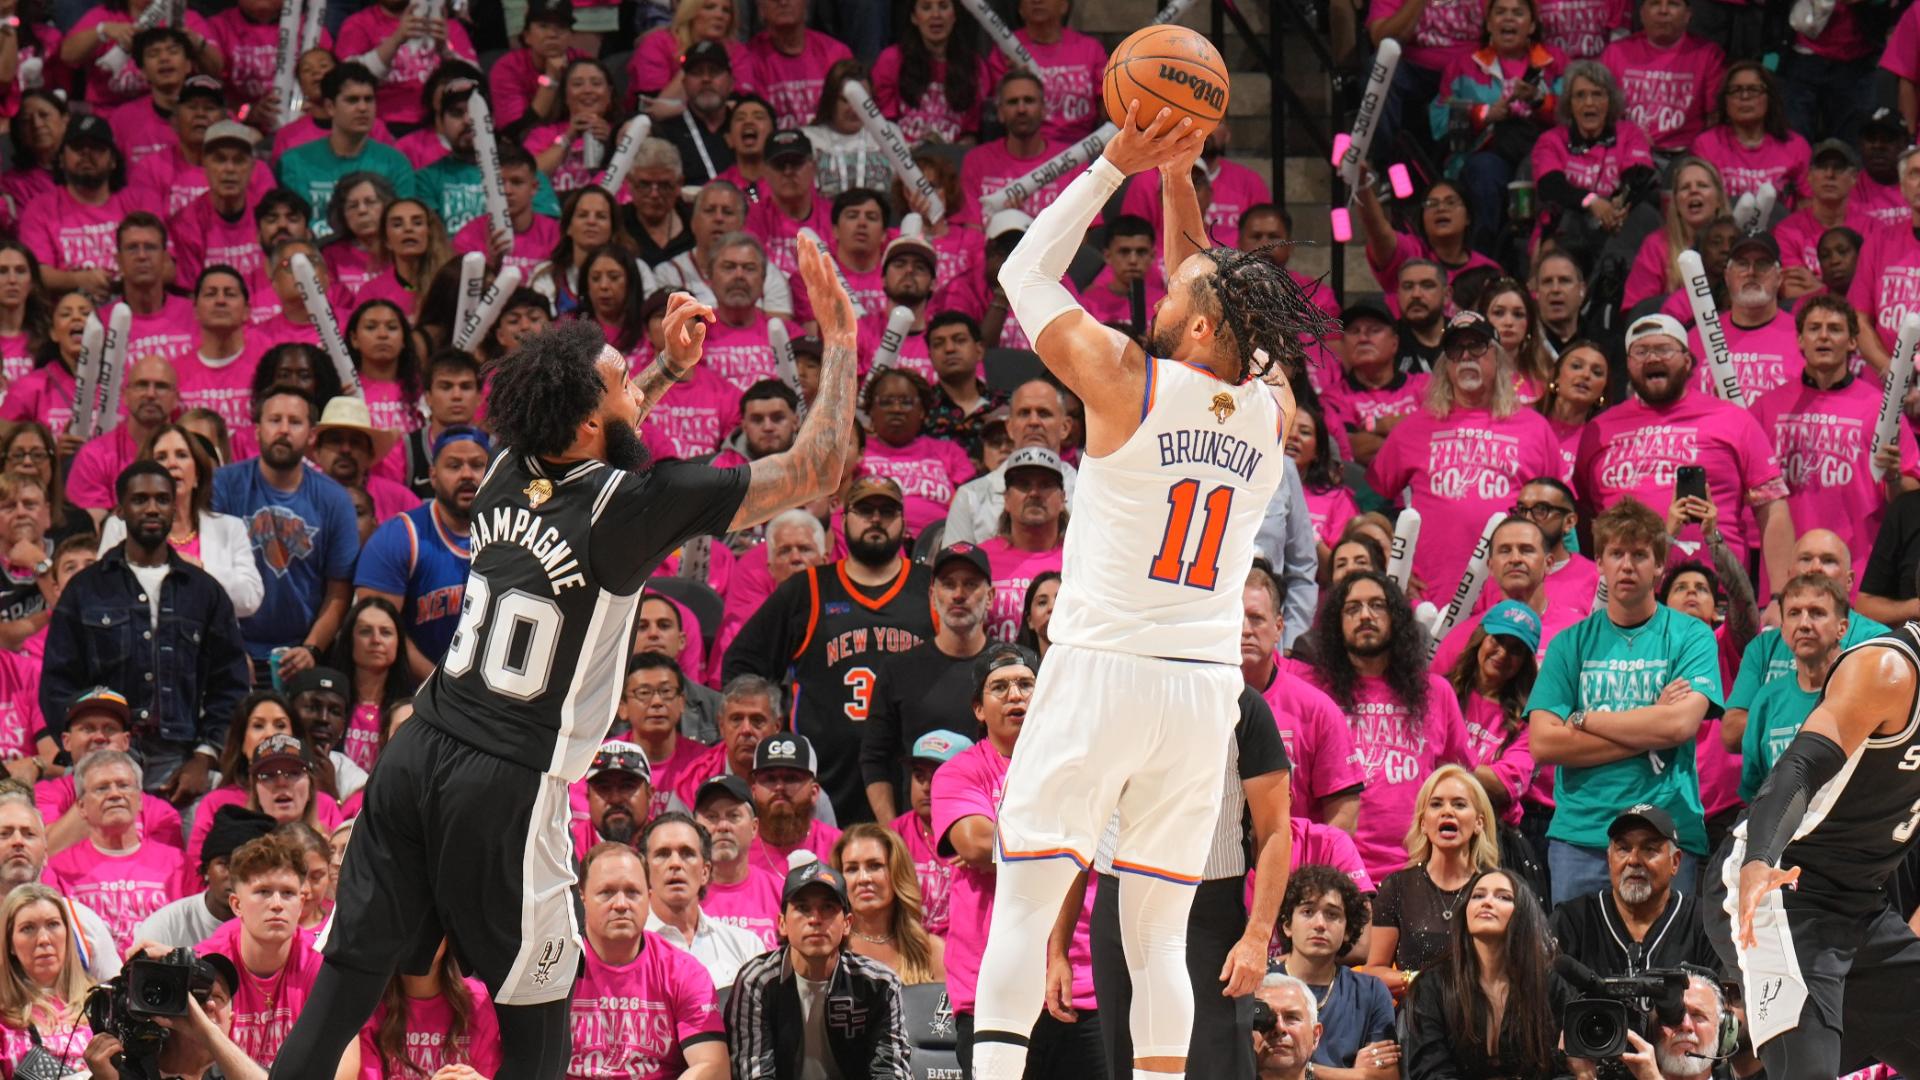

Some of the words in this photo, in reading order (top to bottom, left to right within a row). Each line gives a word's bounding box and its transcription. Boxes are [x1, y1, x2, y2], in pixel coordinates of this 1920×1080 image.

[1159, 63, 1226, 112] Wilson
[1658, 106, 1686, 132] GO
[1031, 151, 1078, 187] SPURS
[1692, 274, 1712, 298] GO
[1703, 309, 1730, 365] SPURS
[1456, 427, 1493, 440] 2026
[1637, 425, 1673, 437] 2026
[1803, 413, 1839, 425] 2026
[1157, 429, 1263, 483] BRUNSON
[1429, 439, 1520, 477] FINALS
[1603, 432, 1700, 468] FINALS
[1775, 422, 1864, 463] FINALS
[1430, 467, 1461, 498] GO
[1478, 469, 1510, 500] GO
[1602, 460, 1635, 489] GO
[1655, 460, 1679, 486] G
[1821, 454, 1853, 488] GO
[1148, 477, 1235, 592] 11
[416, 585, 465, 625] NEW
[826, 628, 868, 667] NEW
[1608, 658, 1645, 671] 2026
[844, 666, 877, 721] 3
[1357, 703, 1394, 715] 2026
[1580, 670, 1669, 712] FINALS
[1385, 749, 1419, 785] GO
[100, 879, 136, 891] 2026
[599, 996, 640, 1010] 2026
[570, 1010, 673, 1057] FINALS
[566, 1050, 604, 1078] GO
